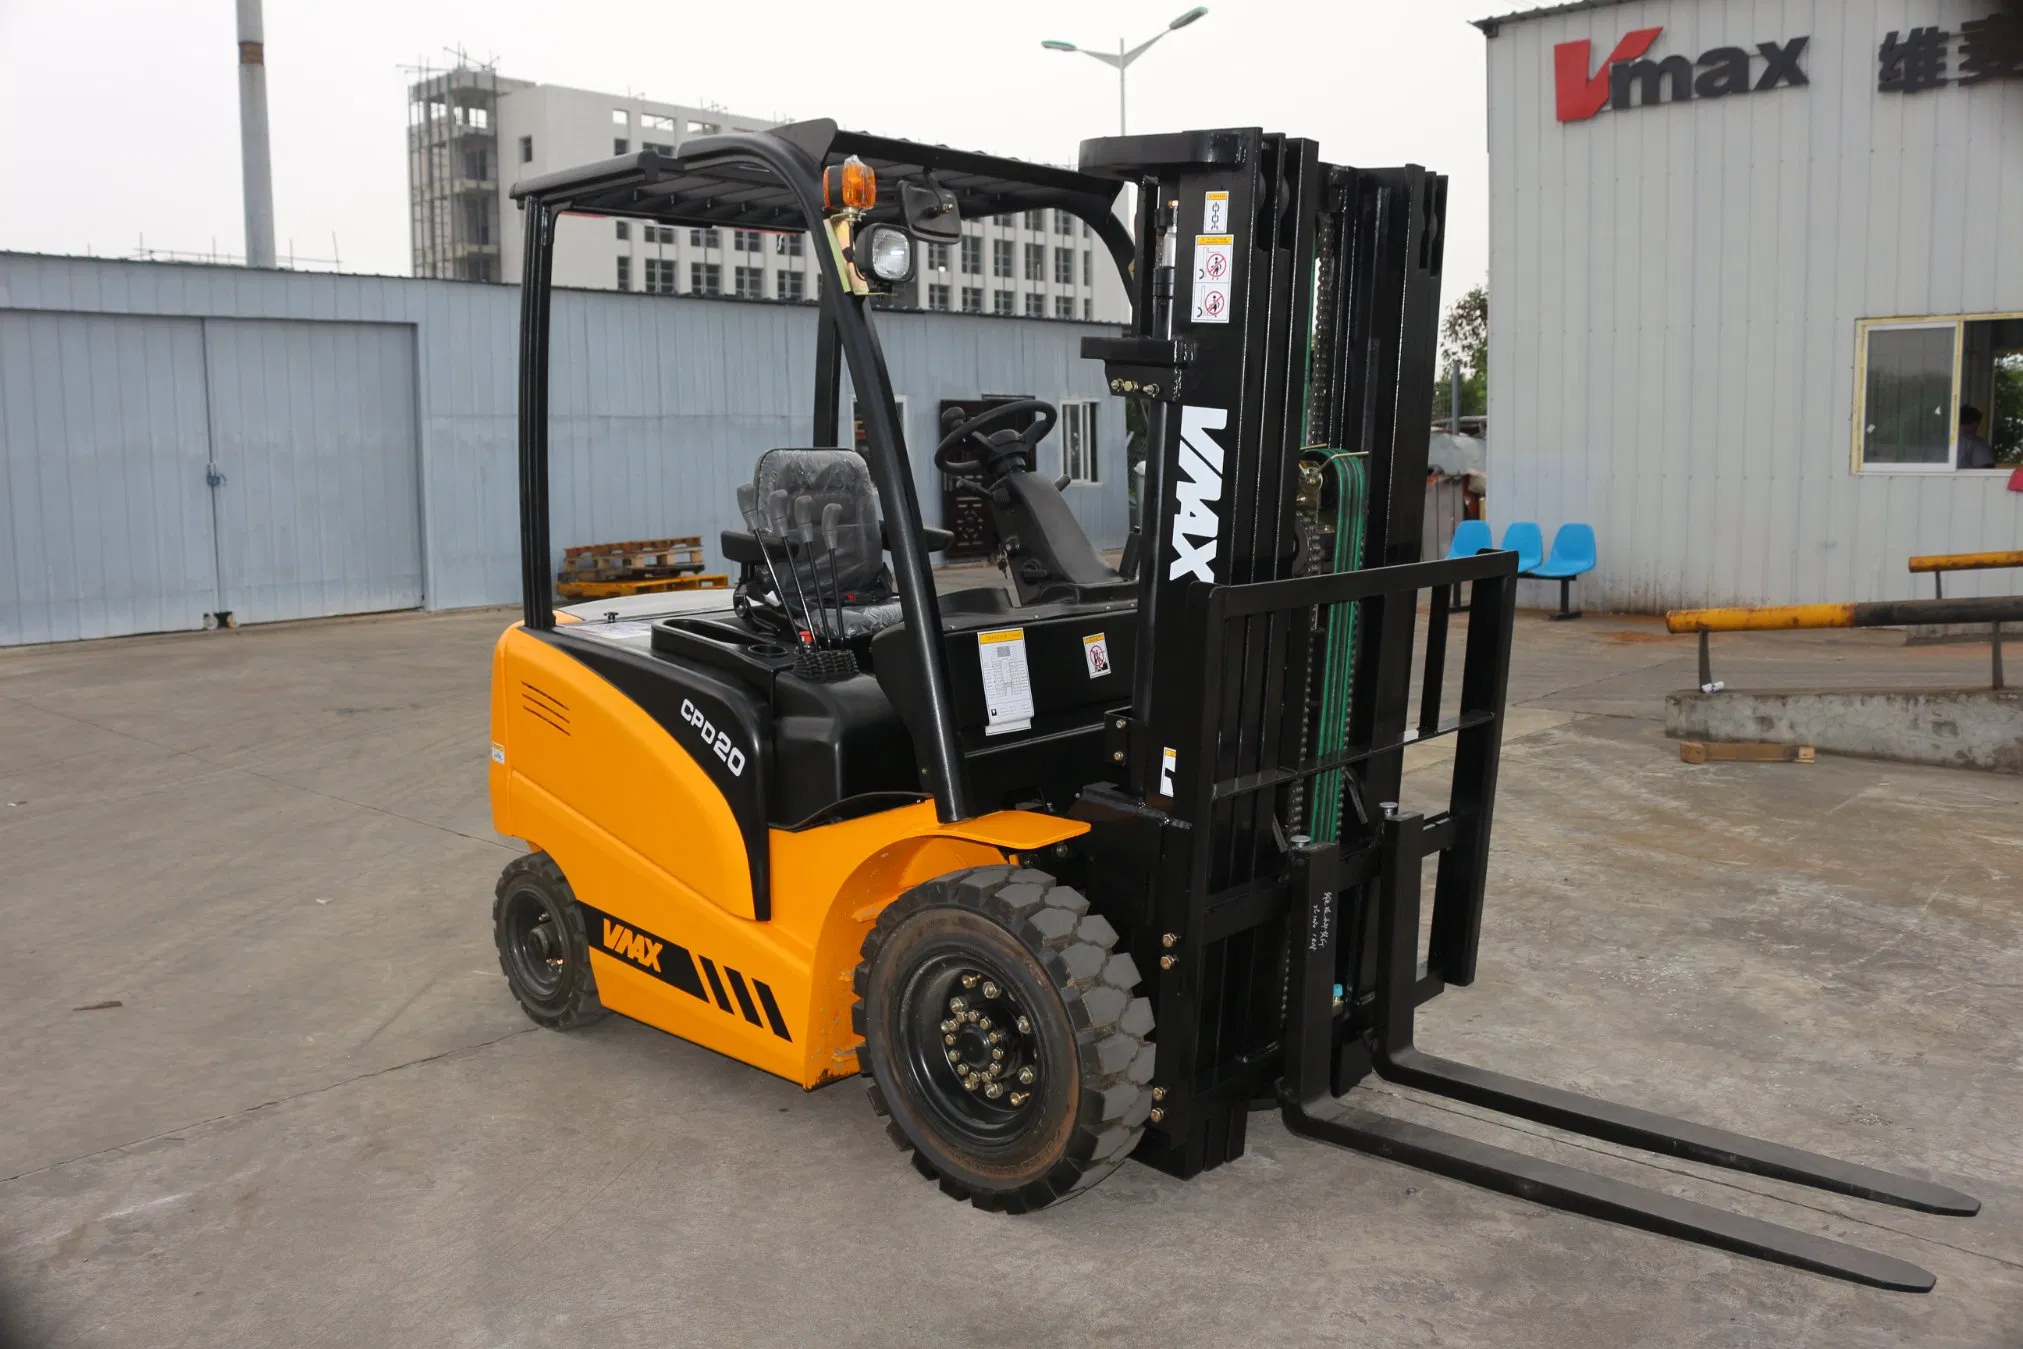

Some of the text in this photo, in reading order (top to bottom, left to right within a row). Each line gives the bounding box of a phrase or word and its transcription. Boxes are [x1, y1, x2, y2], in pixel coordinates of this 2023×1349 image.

[1554, 27, 1810, 122] Vmax
[1170, 406, 1228, 583] VMAX
[681, 699, 745, 776] CPD20
[603, 919, 662, 972] VMAX
